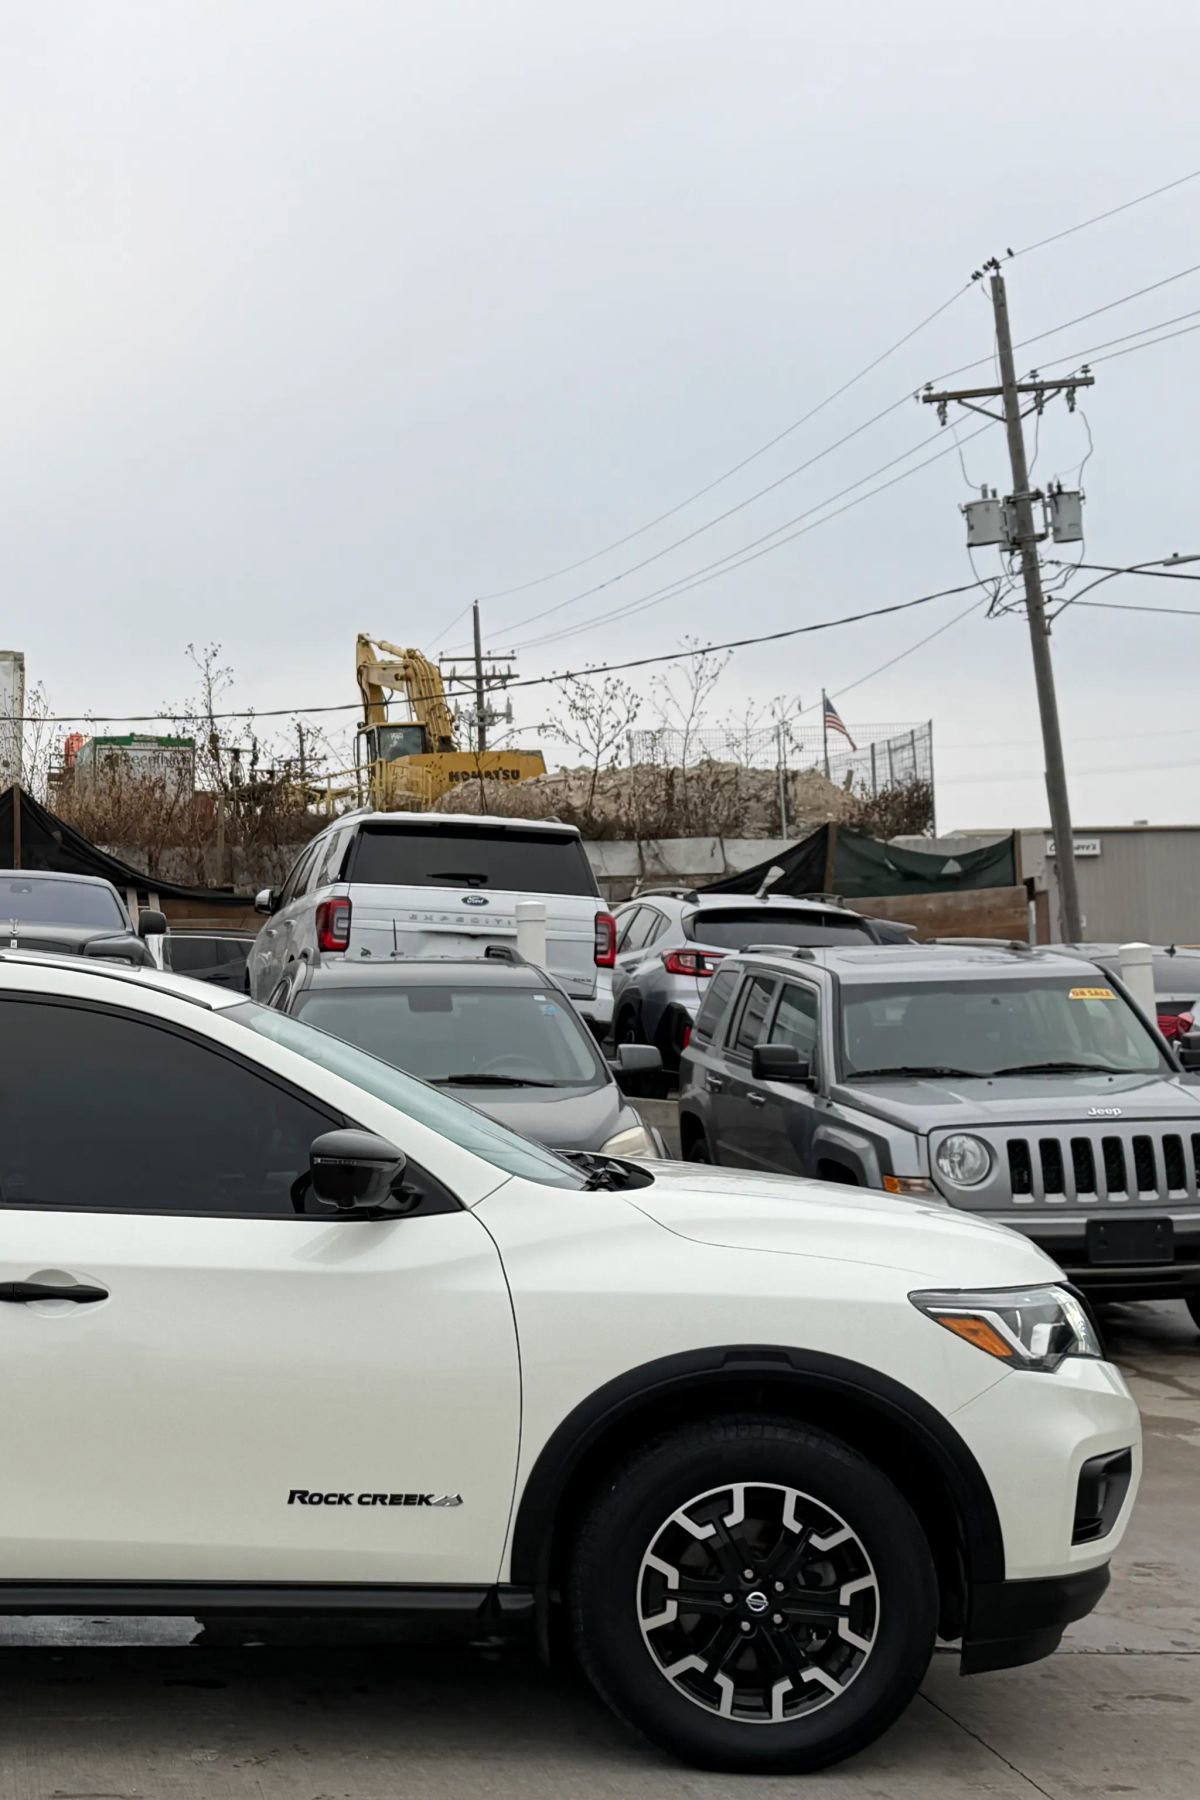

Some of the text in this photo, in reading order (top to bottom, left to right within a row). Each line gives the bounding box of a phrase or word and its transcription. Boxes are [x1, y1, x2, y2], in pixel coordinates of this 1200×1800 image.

[448, 768, 520, 782] KOMATSU
[409, 913, 512, 926] EXPEDITI
[1088, 1107, 1122, 1116] Jeep
[287, 1489, 435, 1506] ROCK CREEK
